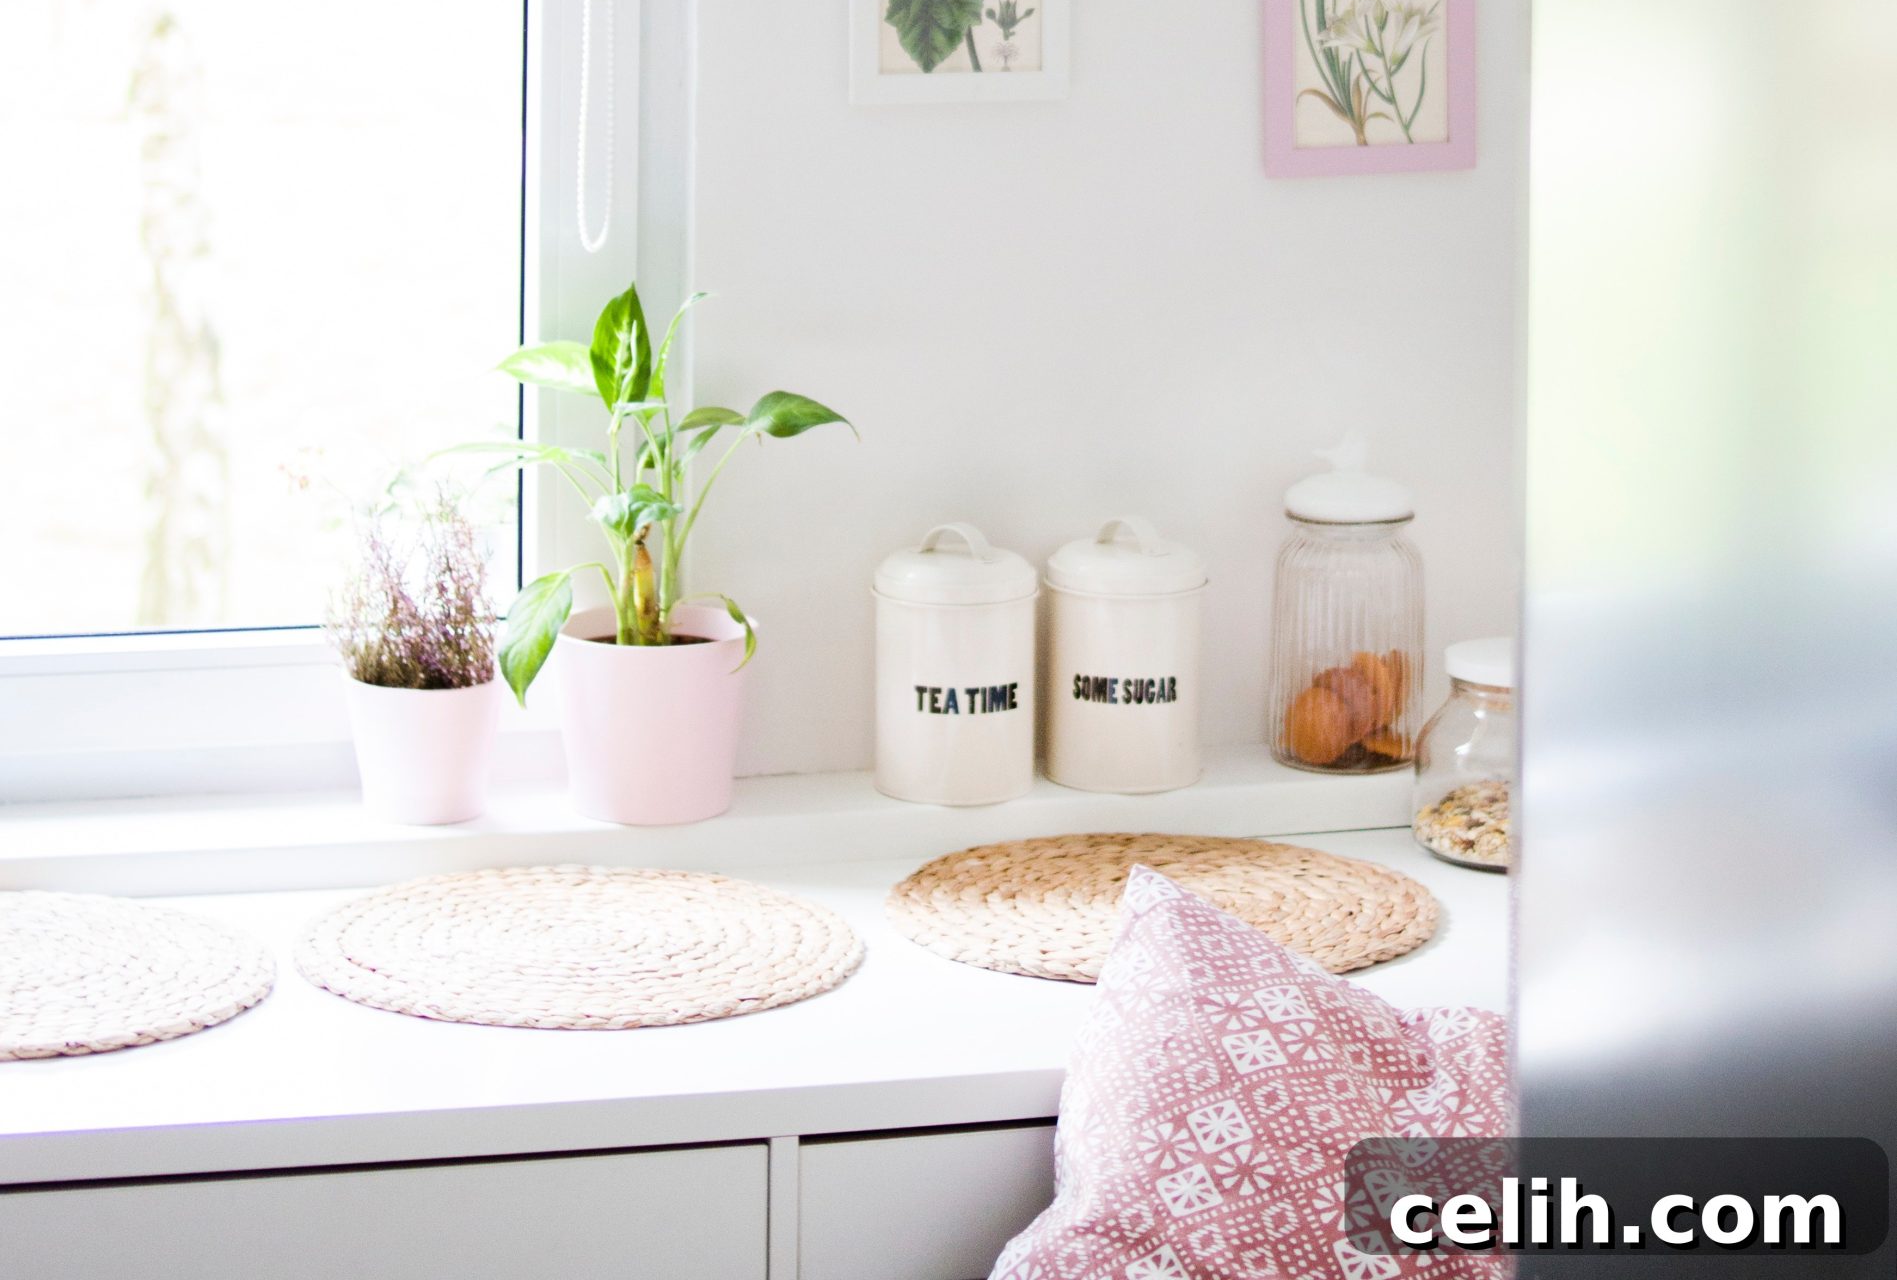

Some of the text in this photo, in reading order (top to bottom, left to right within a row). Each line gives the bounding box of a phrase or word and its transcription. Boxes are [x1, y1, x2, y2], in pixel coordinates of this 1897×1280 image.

[914, 682, 1018, 715] TEA TIME
[1073, 673, 1177, 705] SOME SUGAR
